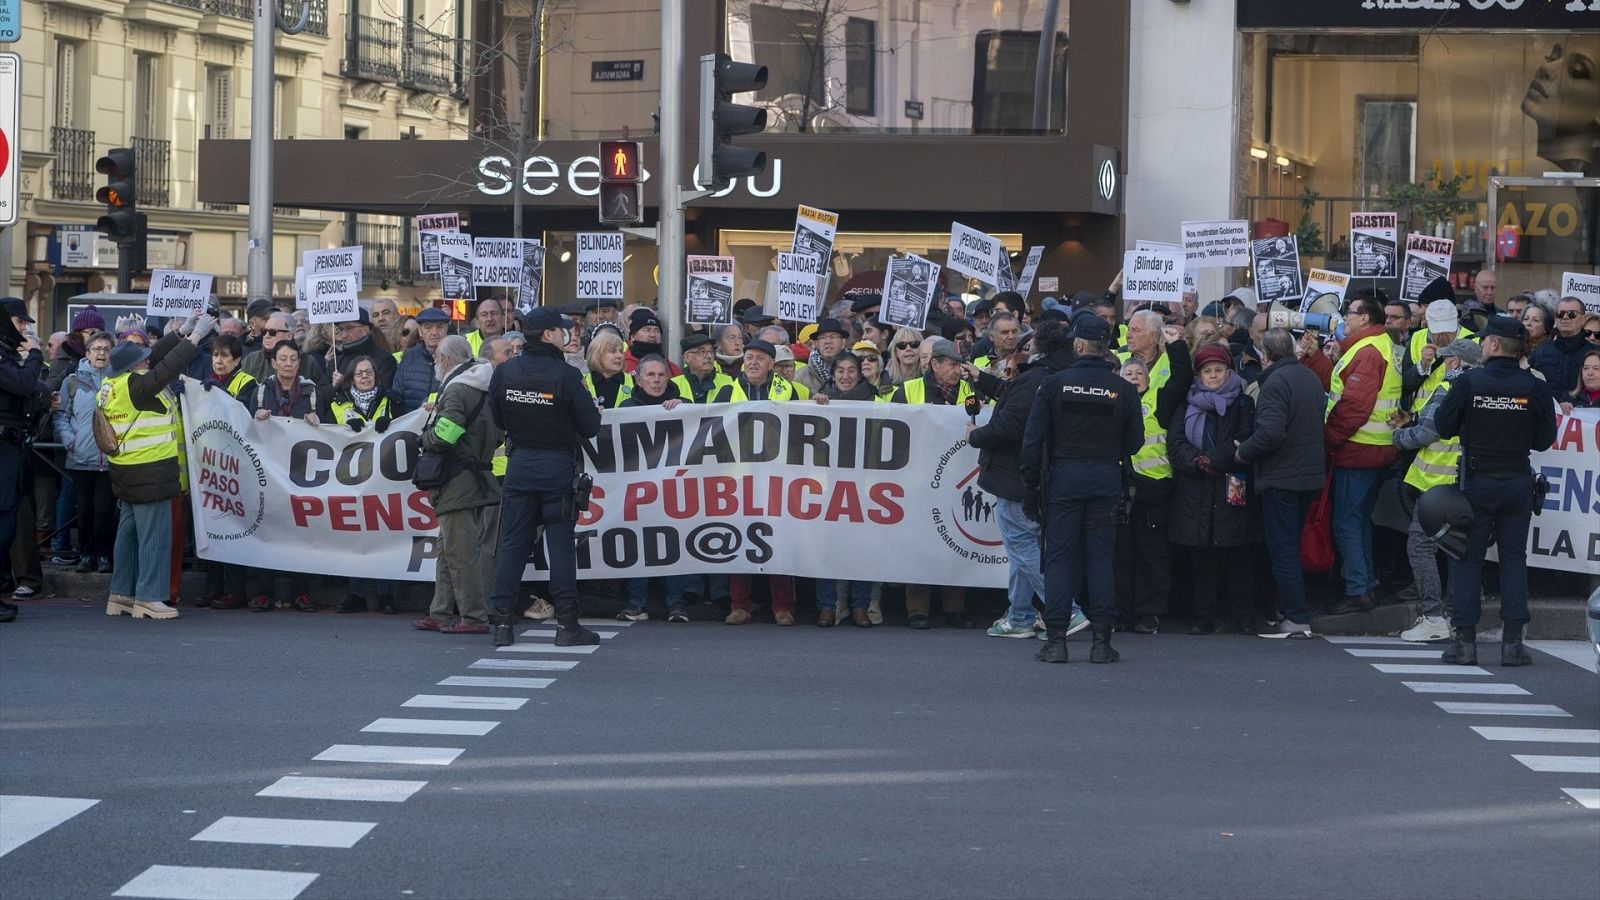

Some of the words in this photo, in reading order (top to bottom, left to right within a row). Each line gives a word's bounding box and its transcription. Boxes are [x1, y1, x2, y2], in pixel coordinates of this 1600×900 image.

[419, 216, 458, 231] ¡BASTA!
[1219, 227, 1244, 235] Gobiernos
[1352, 215, 1395, 229] ¡BASTA!
[475, 241, 511, 258] RESTAURAR
[511, 242, 519, 259] EL
[578, 235, 622, 254] ¡BLINDAR
[958, 232, 992, 256] ¡PENSIONES
[1185, 240, 1204, 249] siempre
[1408, 237, 1452, 255] ¡BASTA!
[315, 252, 353, 272] ¡PENSIONES
[952, 248, 995, 277] GARANTIZADAS!
[1186, 252, 1197, 260] para
[1230, 249, 1234, 257] y
[578, 258, 622, 276] pensiones
[689, 259, 733, 273] ¡BASTA!
[779, 254, 816, 274] ¡BLINDAR
[1133, 256, 1163, 273] ¡Blindar
[1164, 260, 1173, 274] ya
[161, 274, 191, 291] ¡Blindar
[191, 279, 201, 293] ya
[474, 266, 483, 282] DE
[484, 266, 498, 283] LAS
[316, 279, 348, 298] ¡PENSIONES
[578, 280, 598, 295] POR
[601, 280, 622, 295] LEY!
[779, 279, 815, 297] pensiones
[1127, 276, 1137, 291] las
[1138, 277, 1179, 294] pensiones!
[152, 293, 164, 308] las
[165, 295, 205, 312] pensiones!
[312, 299, 354, 316] GARANTIZADAS!
[779, 301, 797, 317] POR
[797, 303, 815, 320] LEY!
[506, 389, 544, 399] POLICIA
[1062, 385, 1111, 396] POLICIA
[1473, 395, 1517, 404] POLICIA
[506, 395, 554, 405] NACIONAL
[202, 446, 216, 467] NI
[219, 452, 240, 475] UN
[243, 444, 267, 487] MADRID
[199, 469, 240, 496] PASO
[202, 490, 246, 518] TRAS
[623, 469, 905, 526] PÚBLICAS
[251, 522, 260, 532] DE
[256, 491, 265, 524] PENSIONES
[932, 507, 941, 524] del
[937, 524, 969, 558] Sistema
[970, 550, 1009, 565] Público
[1531, 526, 1576, 560] LA
[575, 522, 774, 571] TOD@S
